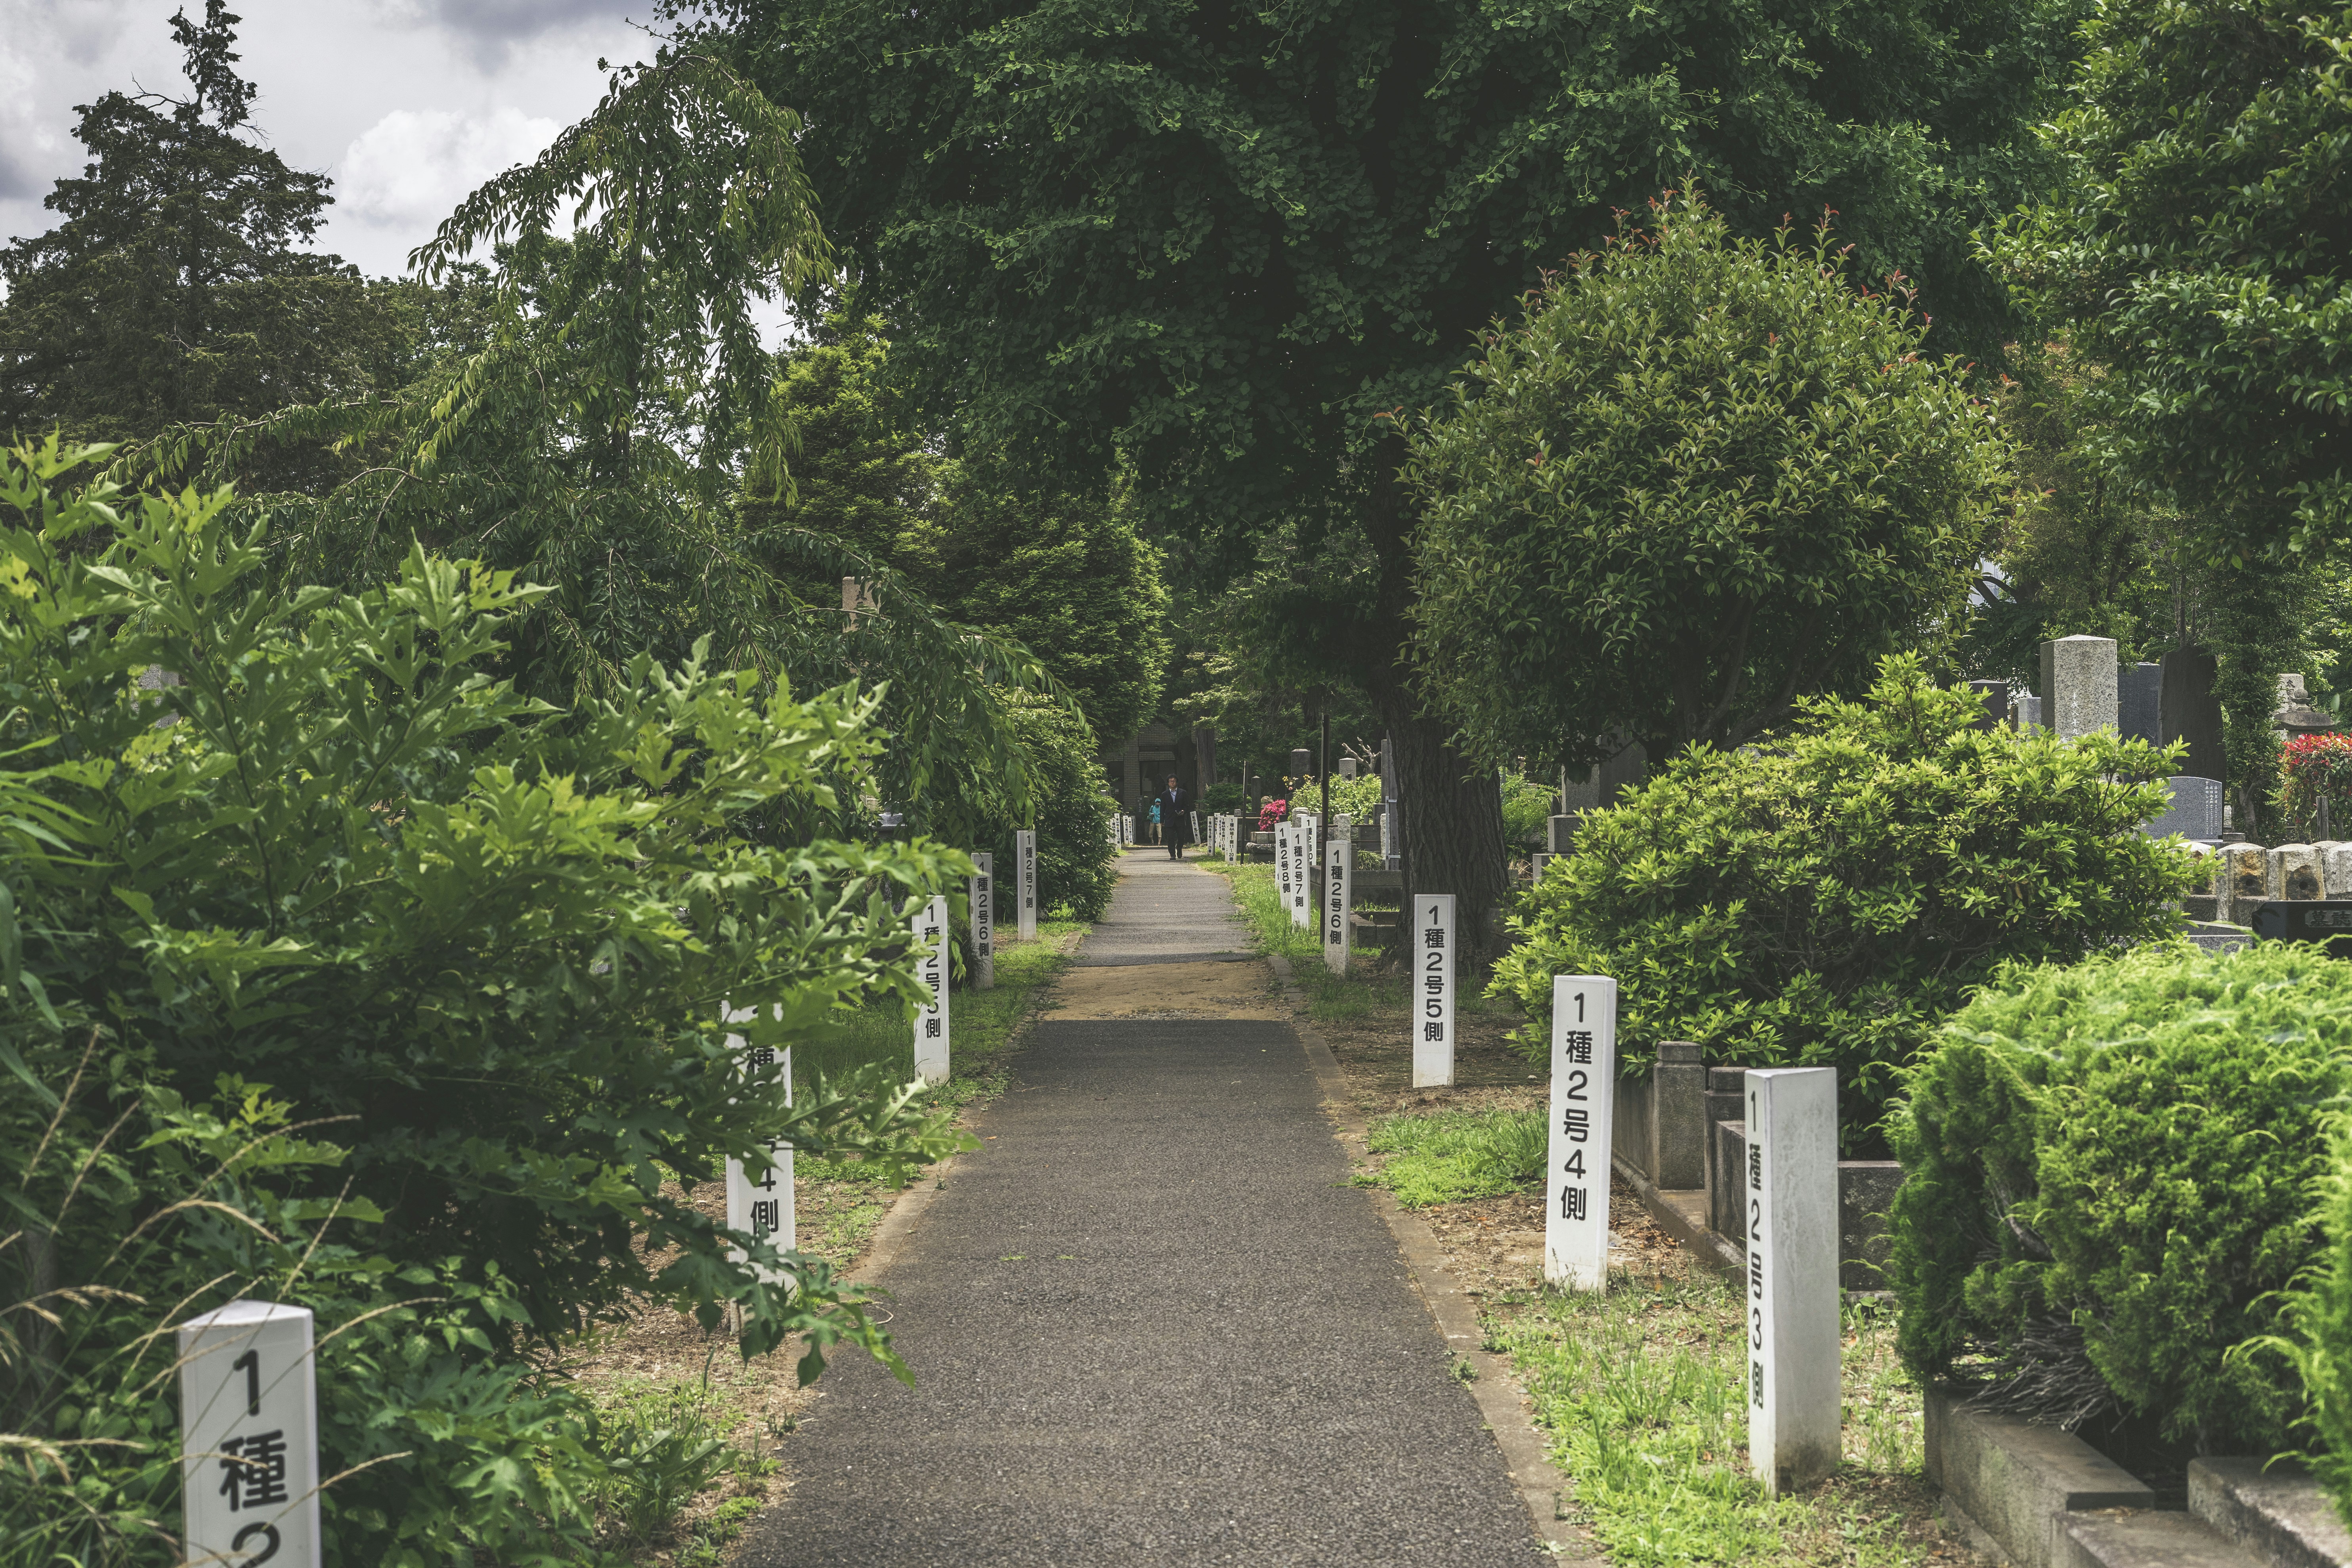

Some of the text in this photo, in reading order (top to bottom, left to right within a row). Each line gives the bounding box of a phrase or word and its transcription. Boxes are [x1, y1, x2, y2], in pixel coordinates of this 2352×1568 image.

[1279, 827, 1290, 893] 1種2号8側
[1294, 833, 1304, 907] 1種2号7側
[1330, 850, 1343, 945] 1種2号6側
[977, 861, 989, 957] 1種2号6側
[2310, 911, 2351, 926] 墓誌
[1423, 905, 1445, 1042] 1種2号5側
[1561, 992, 1593, 1221] 1種2号4側
[1748, 1090, 1764, 1410] 1種2号3側
[219, 1348, 289, 1568] 1種2
